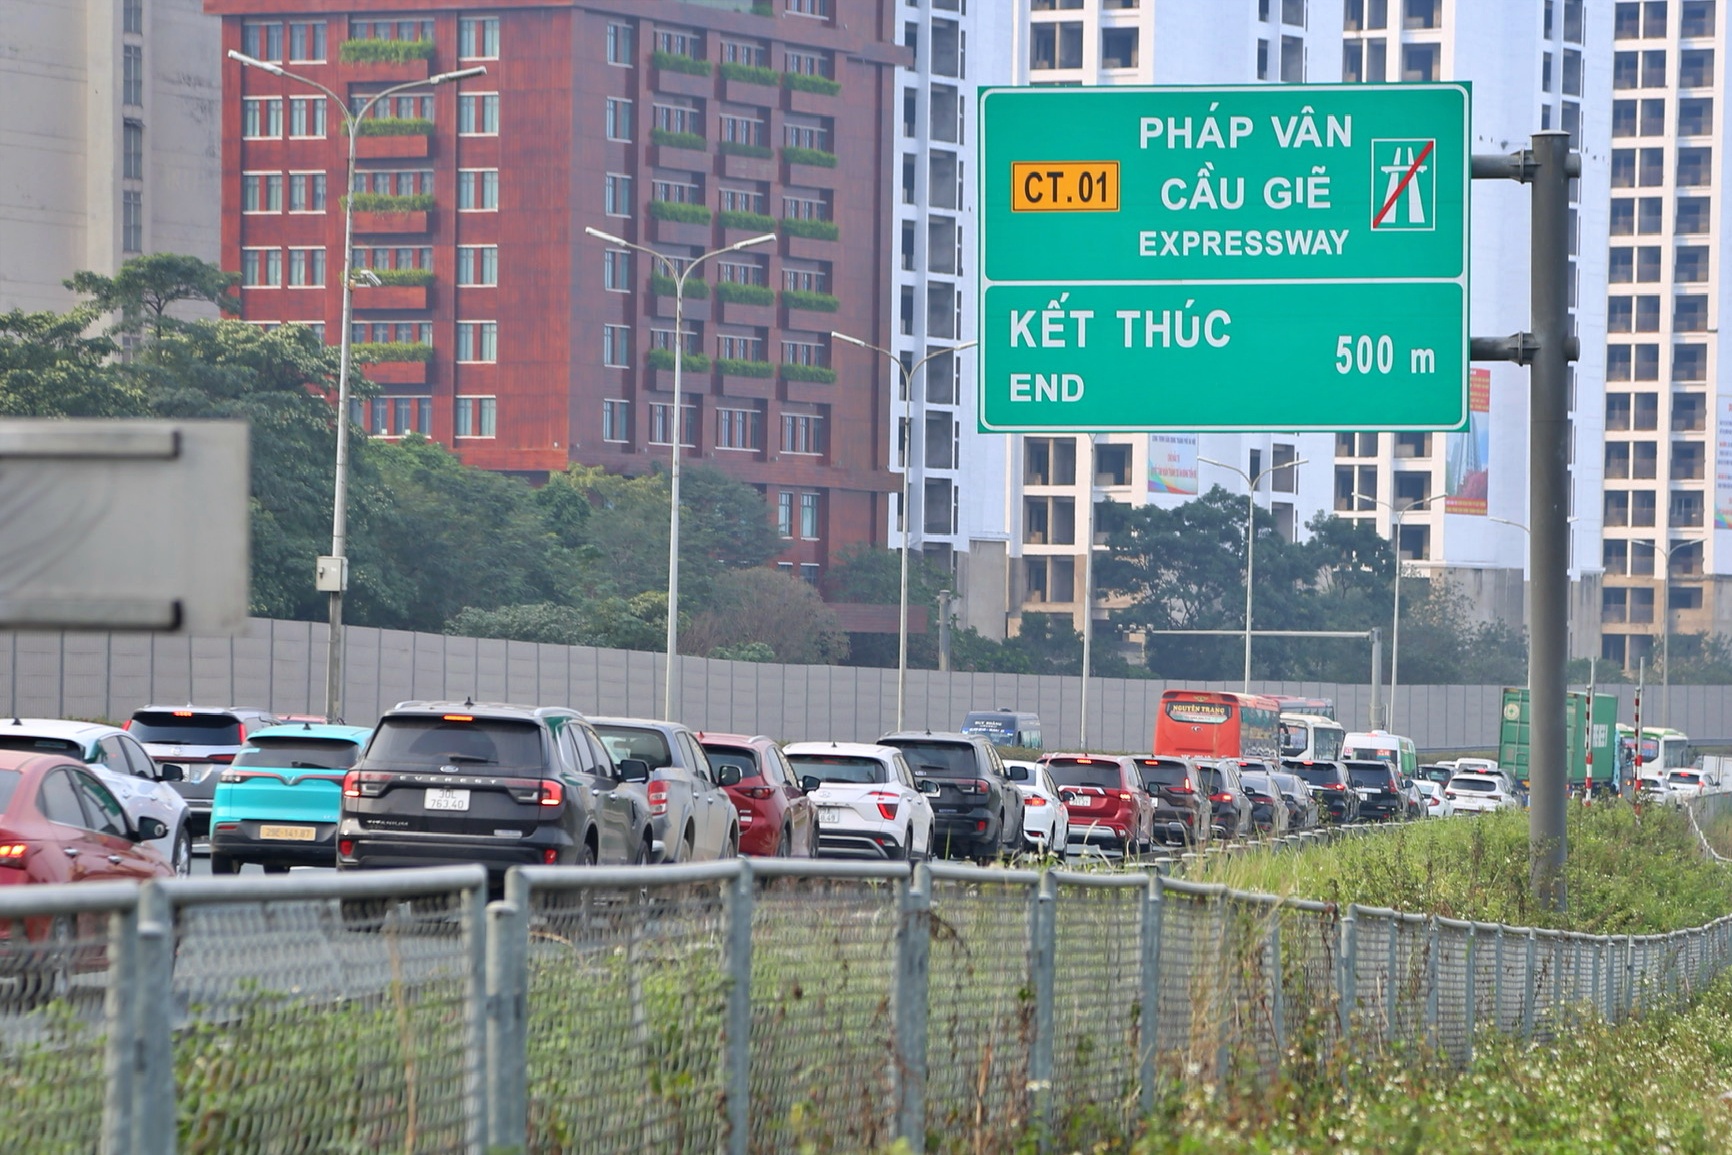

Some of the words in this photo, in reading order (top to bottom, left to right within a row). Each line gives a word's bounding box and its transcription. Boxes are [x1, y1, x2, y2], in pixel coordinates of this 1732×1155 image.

[1140, 102, 1254, 149] PHÁP
[1271, 105, 1352, 148] VÂN
[1024, 171, 1108, 203] CT.01
[1161, 161, 1245, 211] CẦU
[1263, 165, 1331, 210] GIẼ
[1139, 229, 1349, 256] EXPRESSWAY
[1010, 292, 1094, 348] KẾT
[1116, 299, 1231, 348] THÚC
[1335, 334, 1394, 374] 500
[1411, 348, 1435, 374] m
[1010, 373, 1085, 402] END
[399, 775, 497, 785] EVEREST
[430, 799, 464, 809] 763.40
